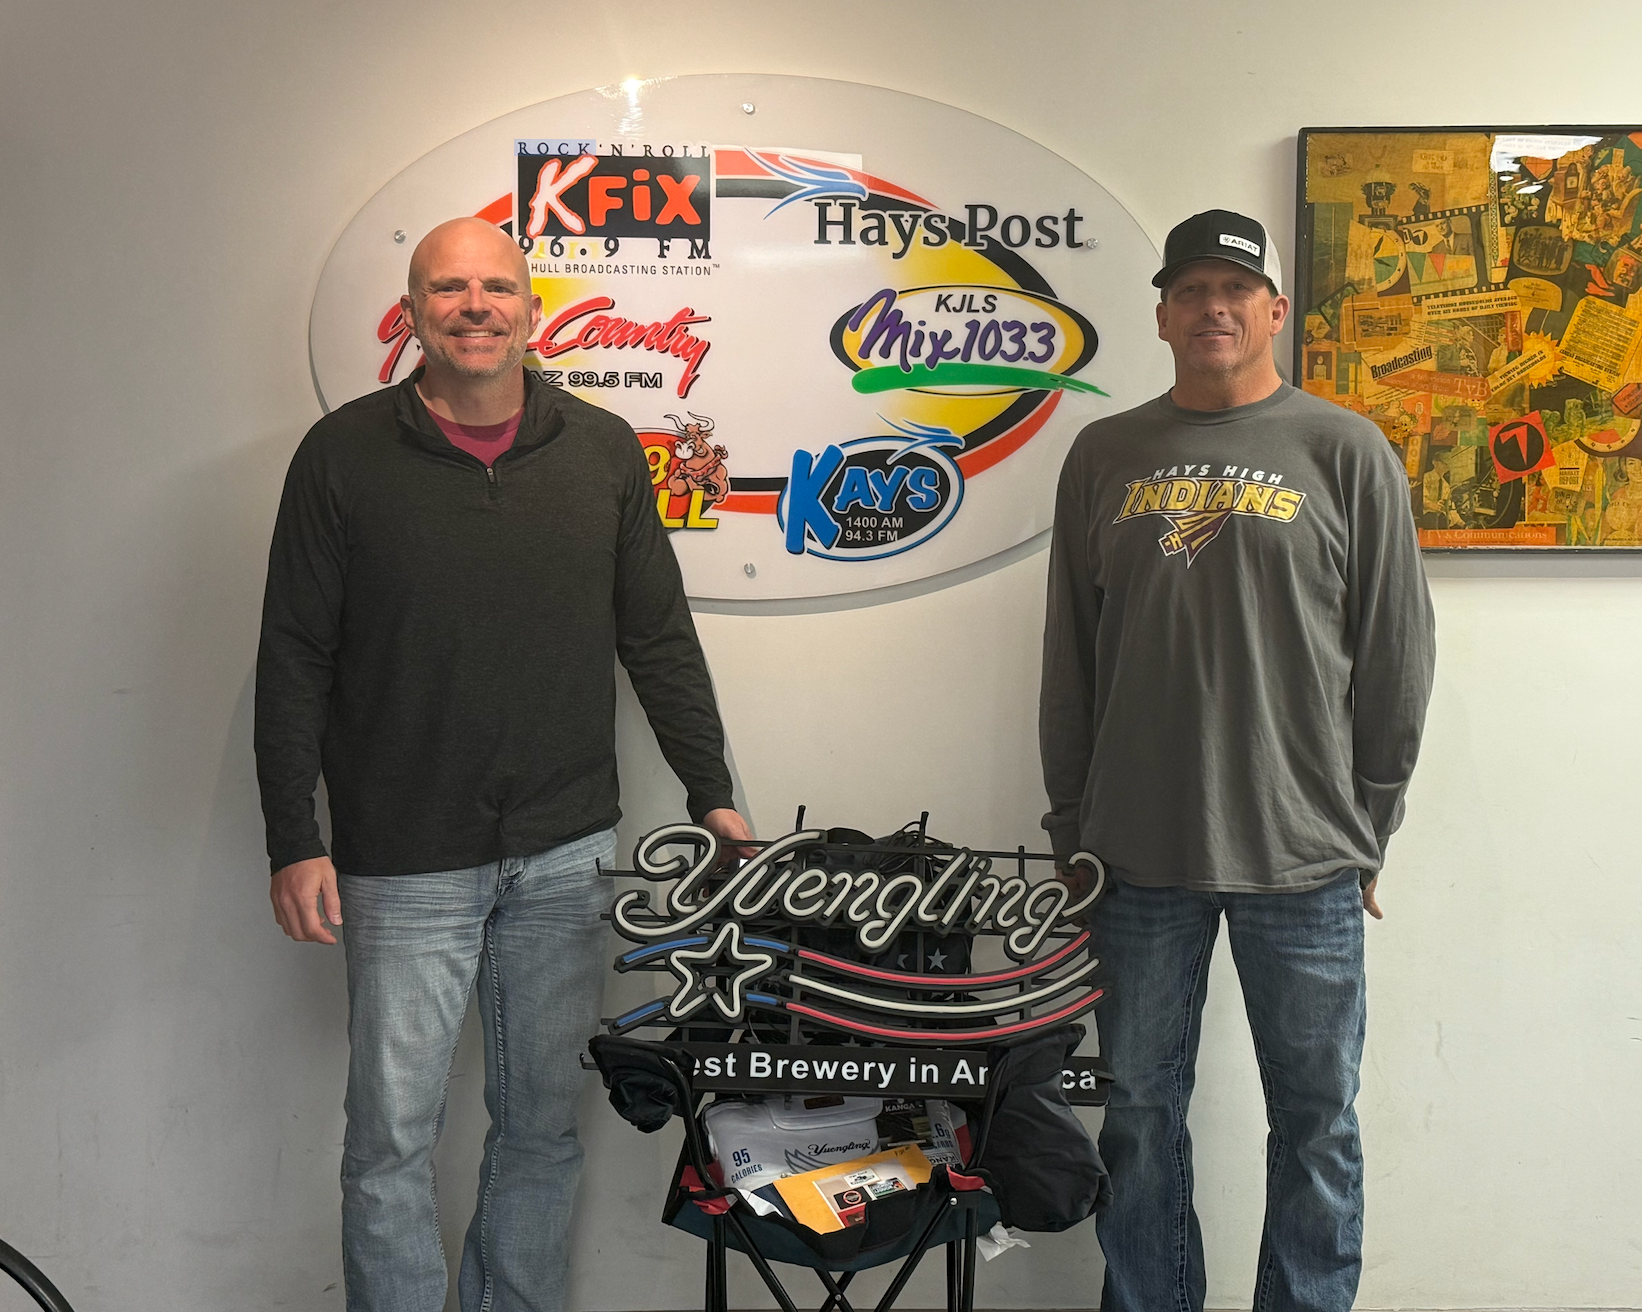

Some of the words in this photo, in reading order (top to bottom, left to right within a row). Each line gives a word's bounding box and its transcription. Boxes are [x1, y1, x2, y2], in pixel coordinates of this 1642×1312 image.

[813, 201, 949, 260] Hays
[963, 203, 1085, 249] Post
[518, 236, 620, 258] 96.9
[657, 237, 712, 259] FM
[1231, 239, 1258, 252] ARIAT
[531, 263, 560, 274] HULL
[564, 264, 657, 276] BROADCASTING
[935, 294, 998, 313] KJLS
[1370, 345, 1433, 379] Broadcasting
[568, 371, 619, 388] 99.5
[625, 372, 663, 388] FM
[1152, 464, 1211, 481] HAYS
[1222, 465, 1284, 485] HIGH
[785, 444, 940, 555] KAYS
[1114, 478, 1306, 523] INDIANS
[846, 516, 878, 528] 1400
[881, 517, 904, 528] AM
[845, 530, 873, 541] 94.3
[878, 530, 899, 541] FM
[1454, 530, 1548, 540] Communications
[612, 822, 1107, 956] Yuengling
[749, 1051, 897, 1089] Brewery
[909, 1057, 940, 1084] in
[807, 1138, 871, 1156] Yuengling
[732, 1148, 751, 1167] 95
[731, 1163, 763, 1184] CALORIES
